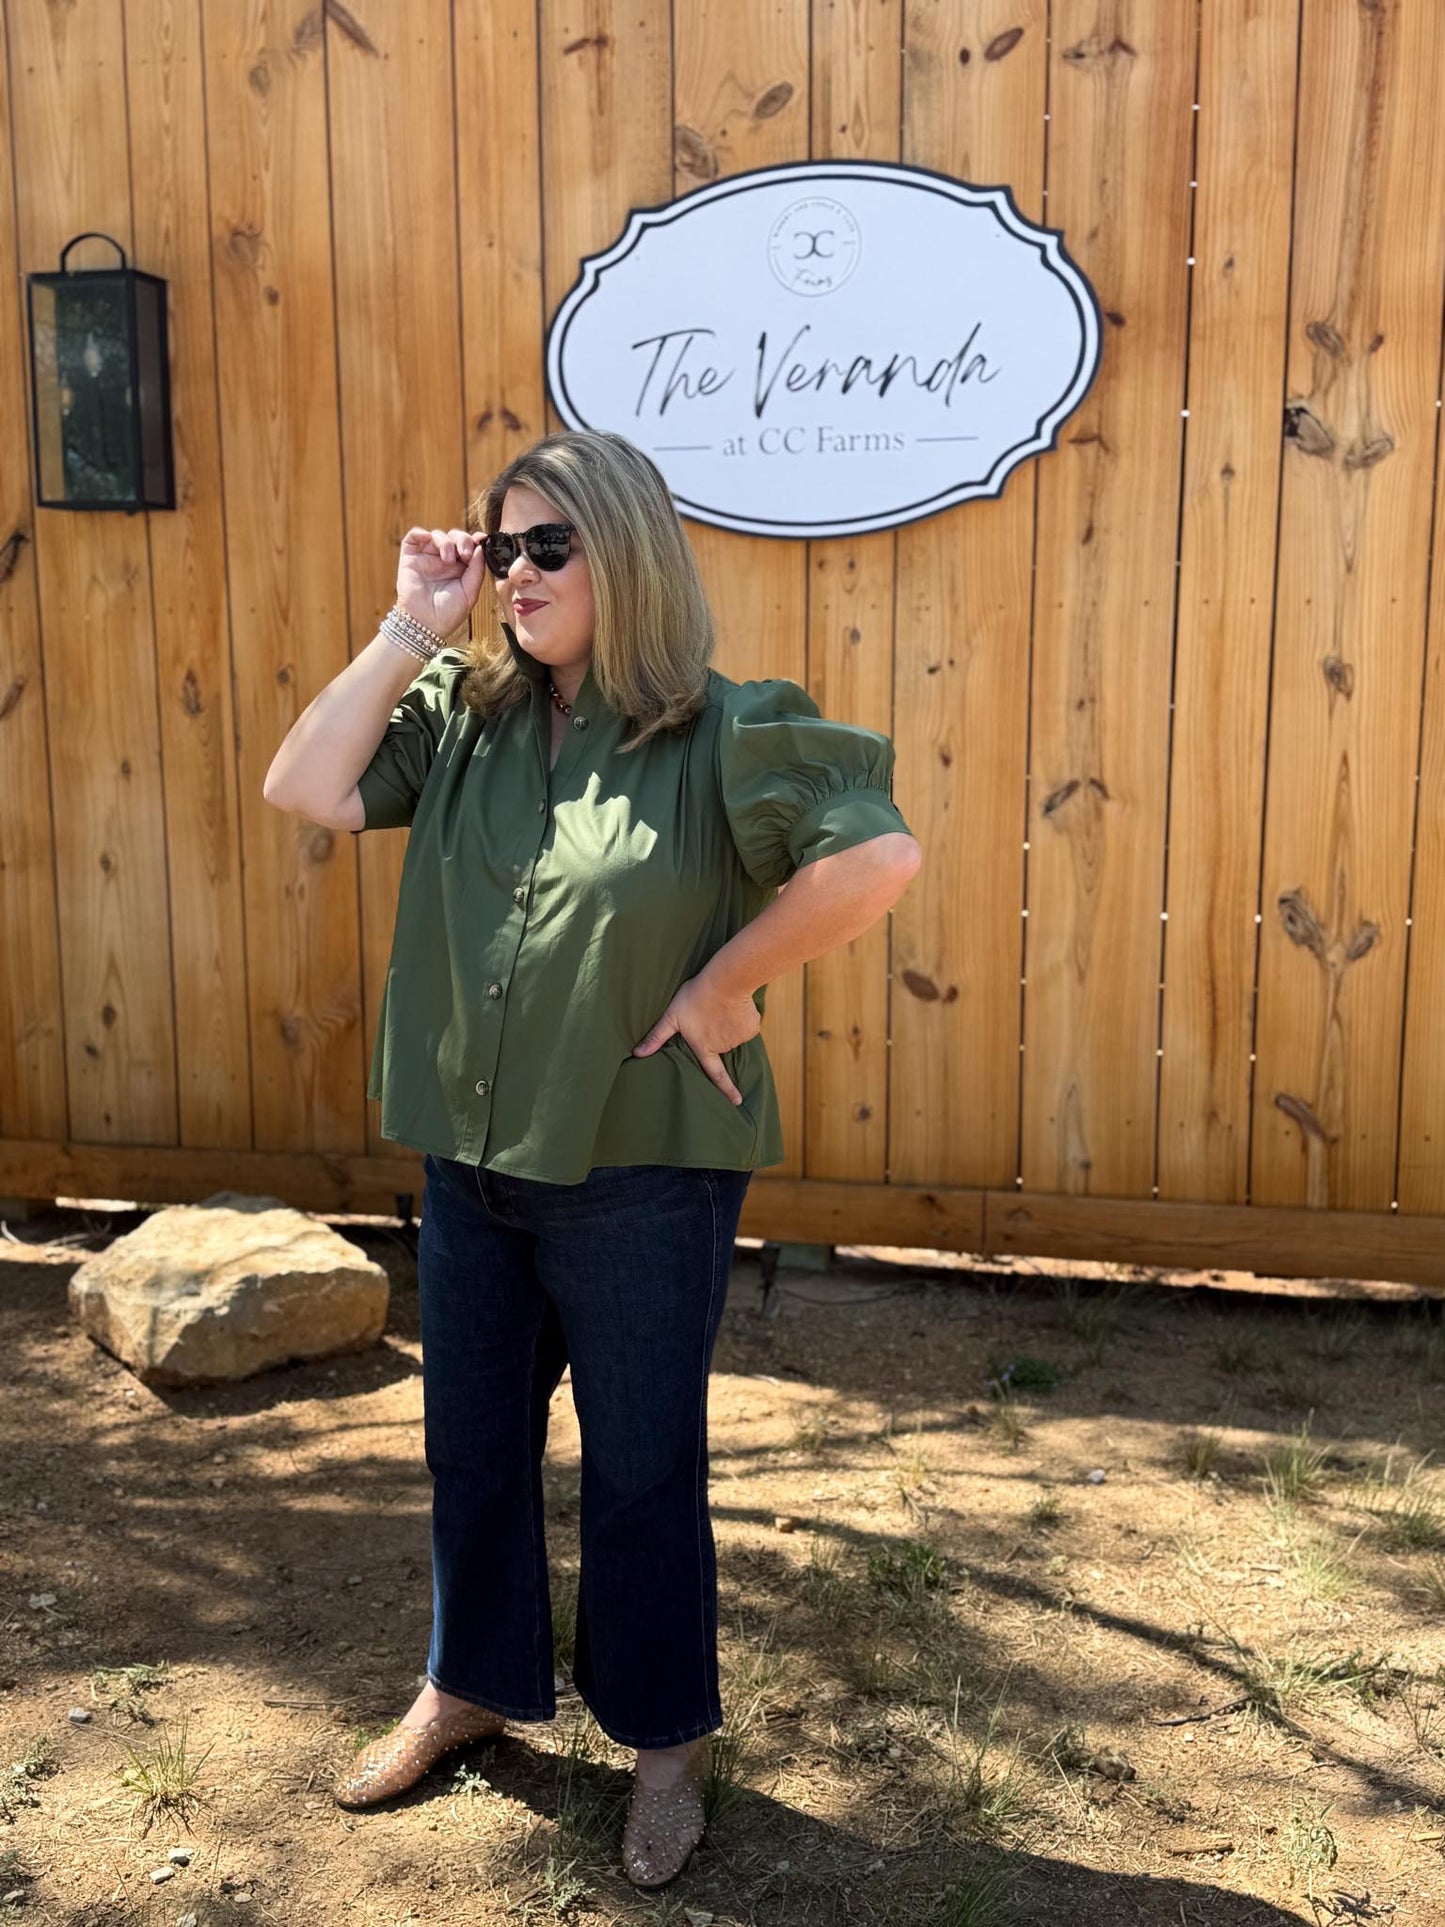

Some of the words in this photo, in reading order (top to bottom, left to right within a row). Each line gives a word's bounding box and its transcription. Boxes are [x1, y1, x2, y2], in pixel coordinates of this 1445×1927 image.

[631, 328, 735, 418] The
[754, 322, 1002, 420] Veranda
[722, 433, 748, 457] at
[758, 428, 806, 455] CC
[817, 426, 906, 454] Farms
